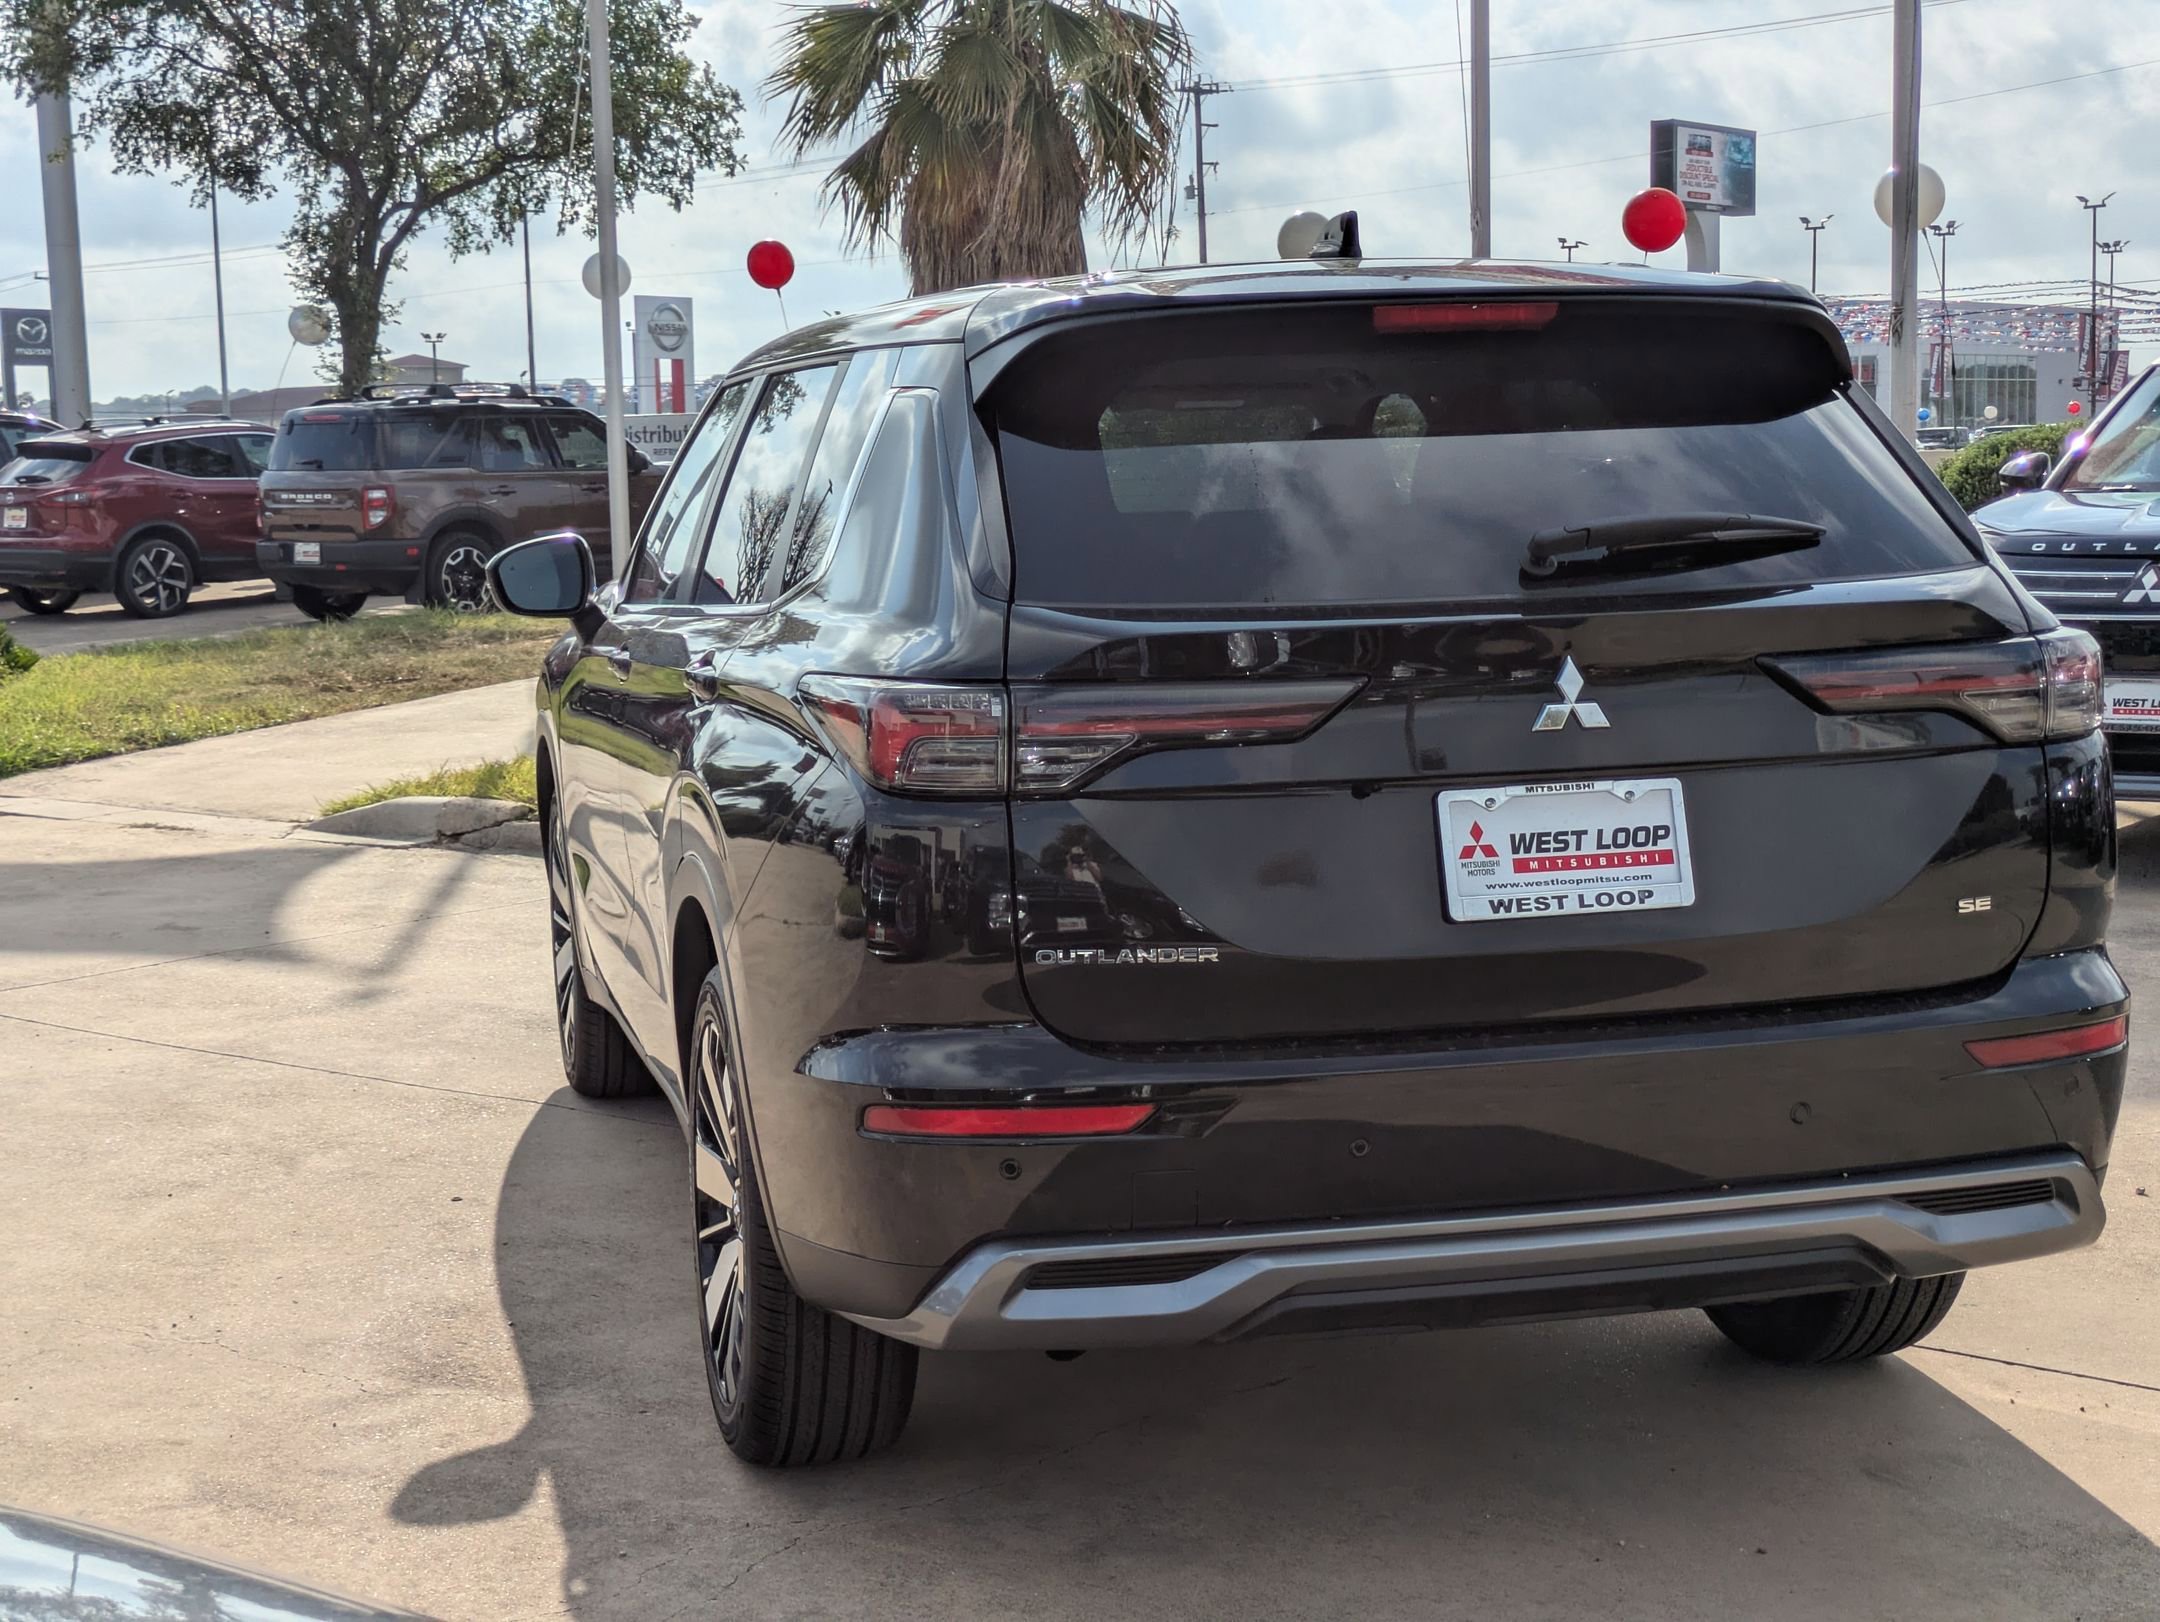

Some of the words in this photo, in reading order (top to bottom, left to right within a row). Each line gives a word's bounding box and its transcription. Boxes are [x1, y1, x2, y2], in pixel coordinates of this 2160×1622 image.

[655, 323, 687, 332] NISSAN
[2111, 354, 2128, 392] CENTER
[2113, 698, 2148, 707] WEST
[1525, 782, 1595, 793] MITSUBISHI
[1510, 829, 1588, 854] WEST
[1596, 824, 1671, 850] LOOP
[1461, 860, 1500, 870] MITSUBISHI
[1530, 853, 1660, 870] MITSUBISHI
[1467, 868, 1495, 877] MOTORS
[1486, 873, 1652, 890] www.westloopmitsu.com
[1488, 895, 1569, 914] WEST
[1578, 889, 1654, 909] LOOP
[1958, 896, 1992, 913] SE
[1036, 948, 1219, 965] OUTLANDER
